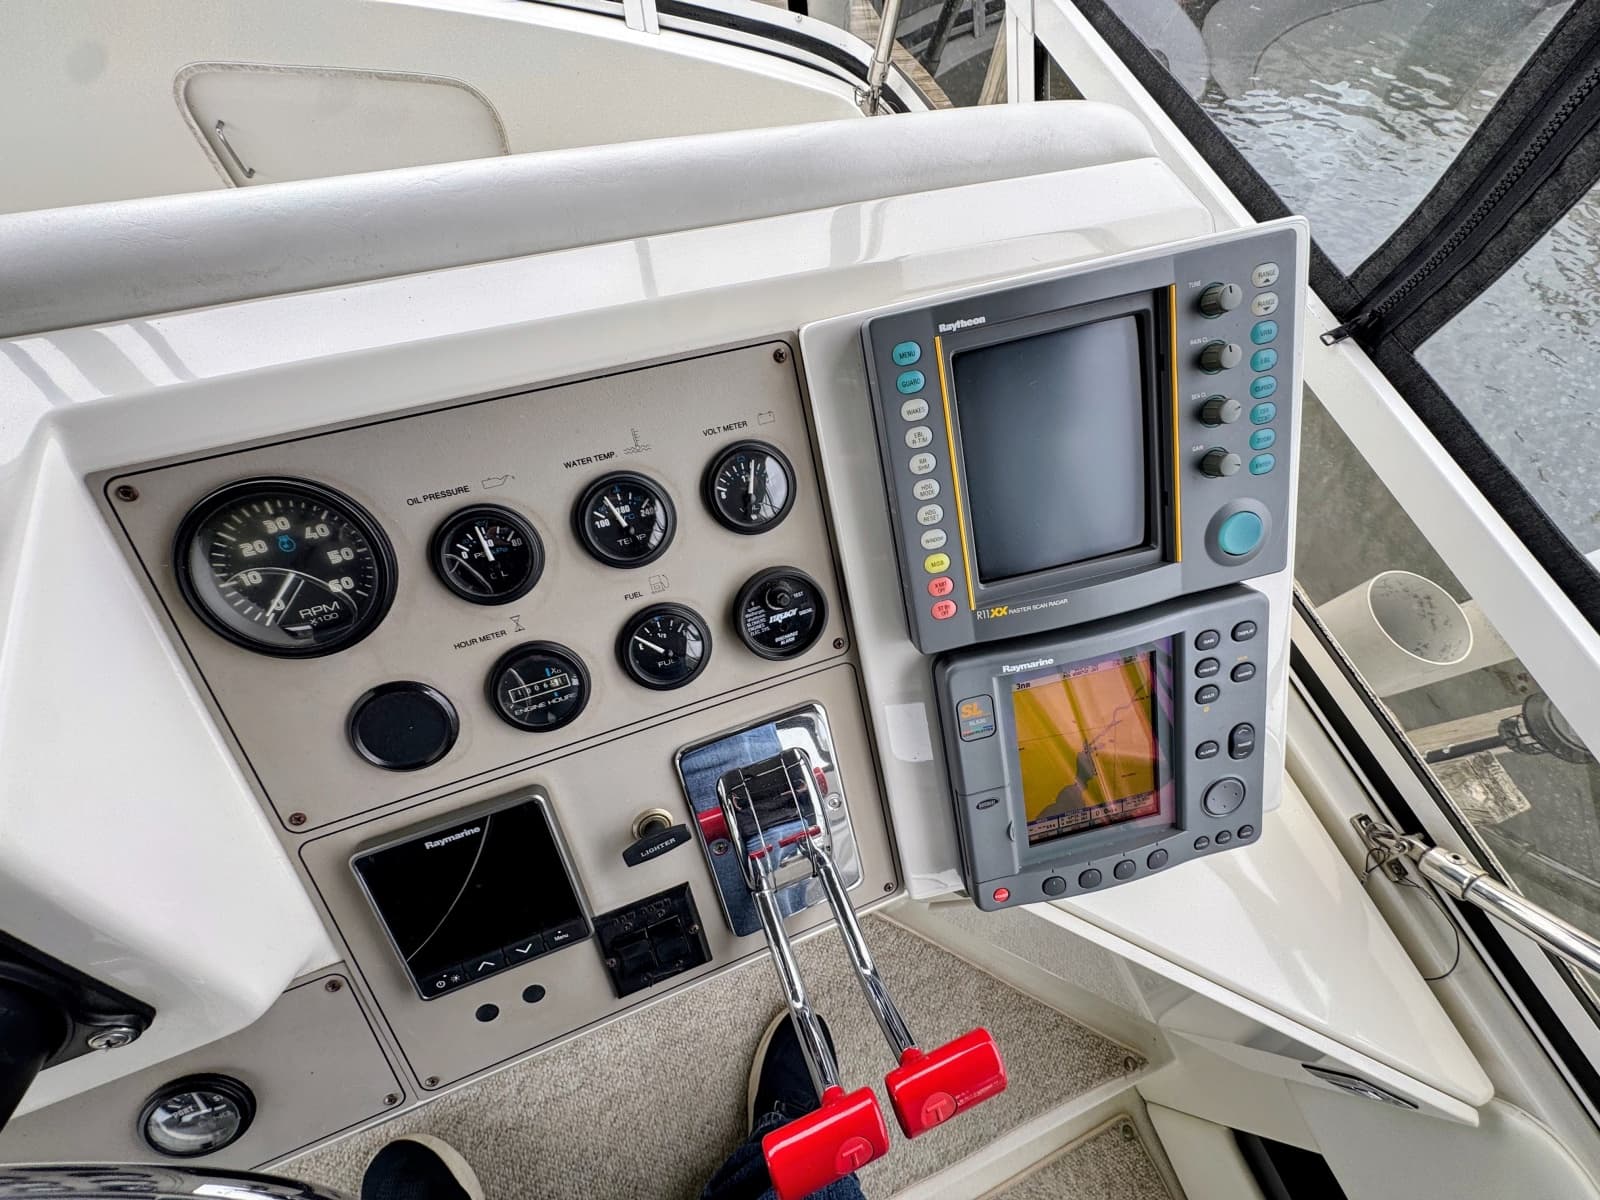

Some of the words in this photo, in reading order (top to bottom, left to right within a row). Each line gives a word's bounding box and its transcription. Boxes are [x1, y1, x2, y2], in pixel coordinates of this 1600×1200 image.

[938, 316, 986, 333] Raytheon
[899, 350, 916, 360] MENU
[702, 426, 721, 437] VOLT
[723, 420, 748, 432] METER
[563, 456, 593, 469] WATER
[406, 497, 423, 506] OIL
[422, 485, 471, 502] PRESSURE
[263, 516, 290, 534] 30
[304, 523, 330, 540] 40
[594, 519, 611, 529] 100
[239, 540, 268, 557] 20
[326, 547, 355, 565] 50
[239, 571, 262, 586] 10
[328, 576, 355, 592] 60
[624, 591, 644, 601] FUEL
[299, 601, 341, 619] RPM
[1008, 606, 1032, 615] RASTER
[1032, 603, 1048, 611] SCAN
[1048, 598, 1068, 607] RADAR
[453, 639, 478, 650] HOUR
[478, 629, 507, 642] METER
[1002, 658, 1055, 673] Raymarine
[960, 702, 983, 719] SL
[424, 825, 481, 850] Raymarine
[640, 837, 676, 858] LIGHTER
[554, 933, 569, 942] Menu
